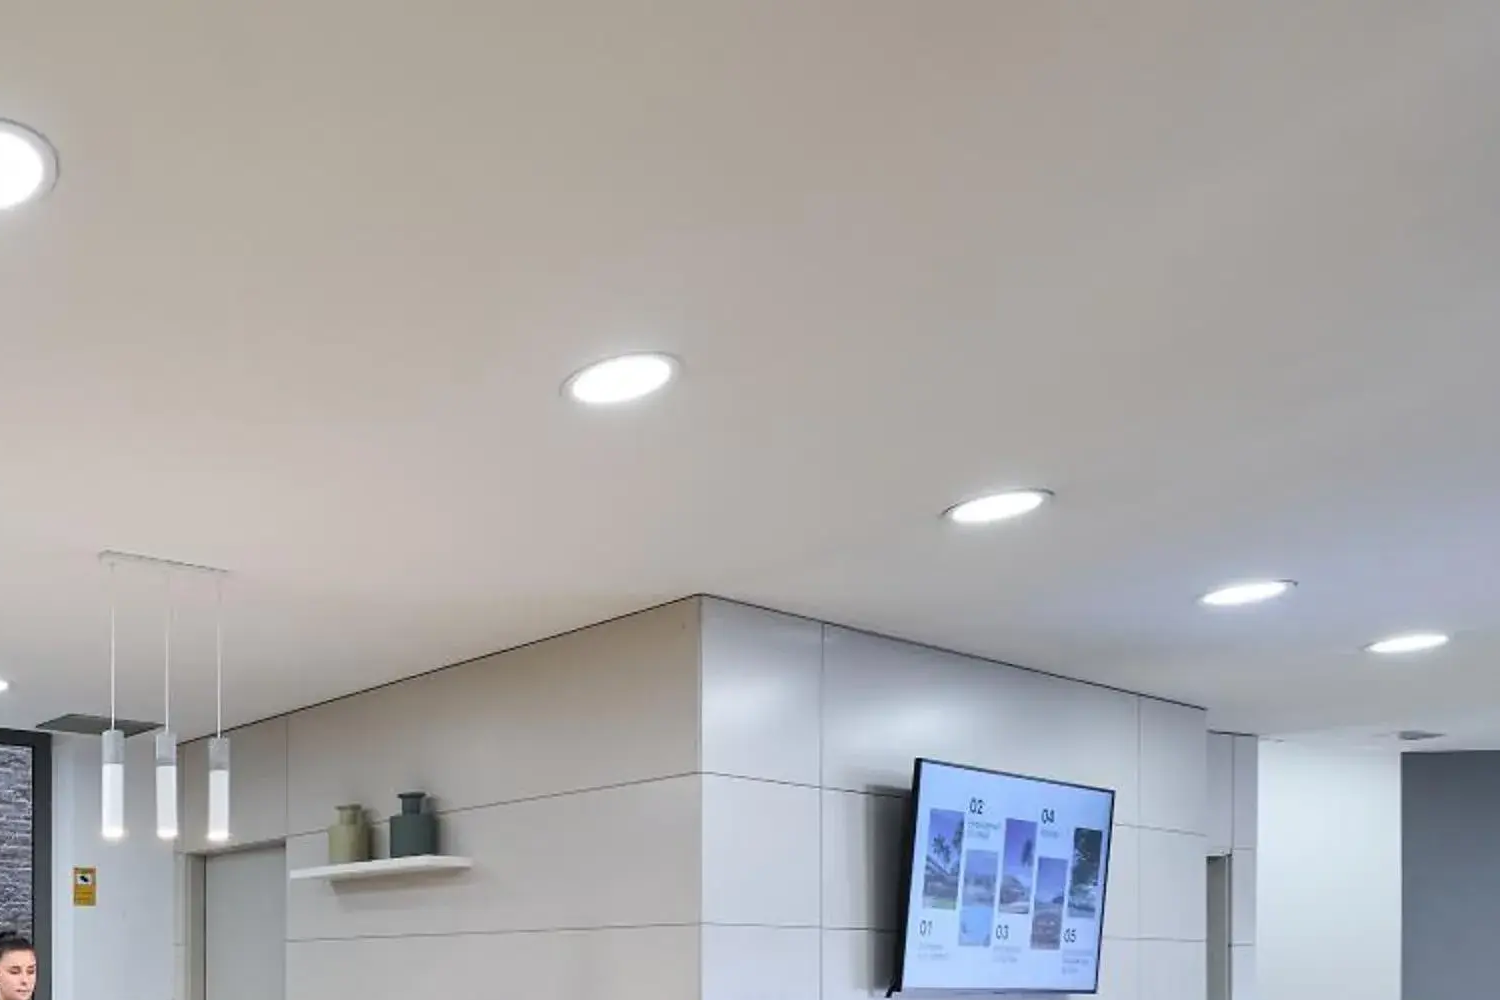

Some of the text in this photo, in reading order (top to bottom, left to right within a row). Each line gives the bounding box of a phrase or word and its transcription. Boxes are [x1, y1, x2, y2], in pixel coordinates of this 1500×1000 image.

[969, 797, 986, 815] 02
[1041, 808, 1056, 824] 04
[919, 920, 934, 936] 01
[995, 924, 1010, 941] 03
[1063, 928, 1077, 943] 05
